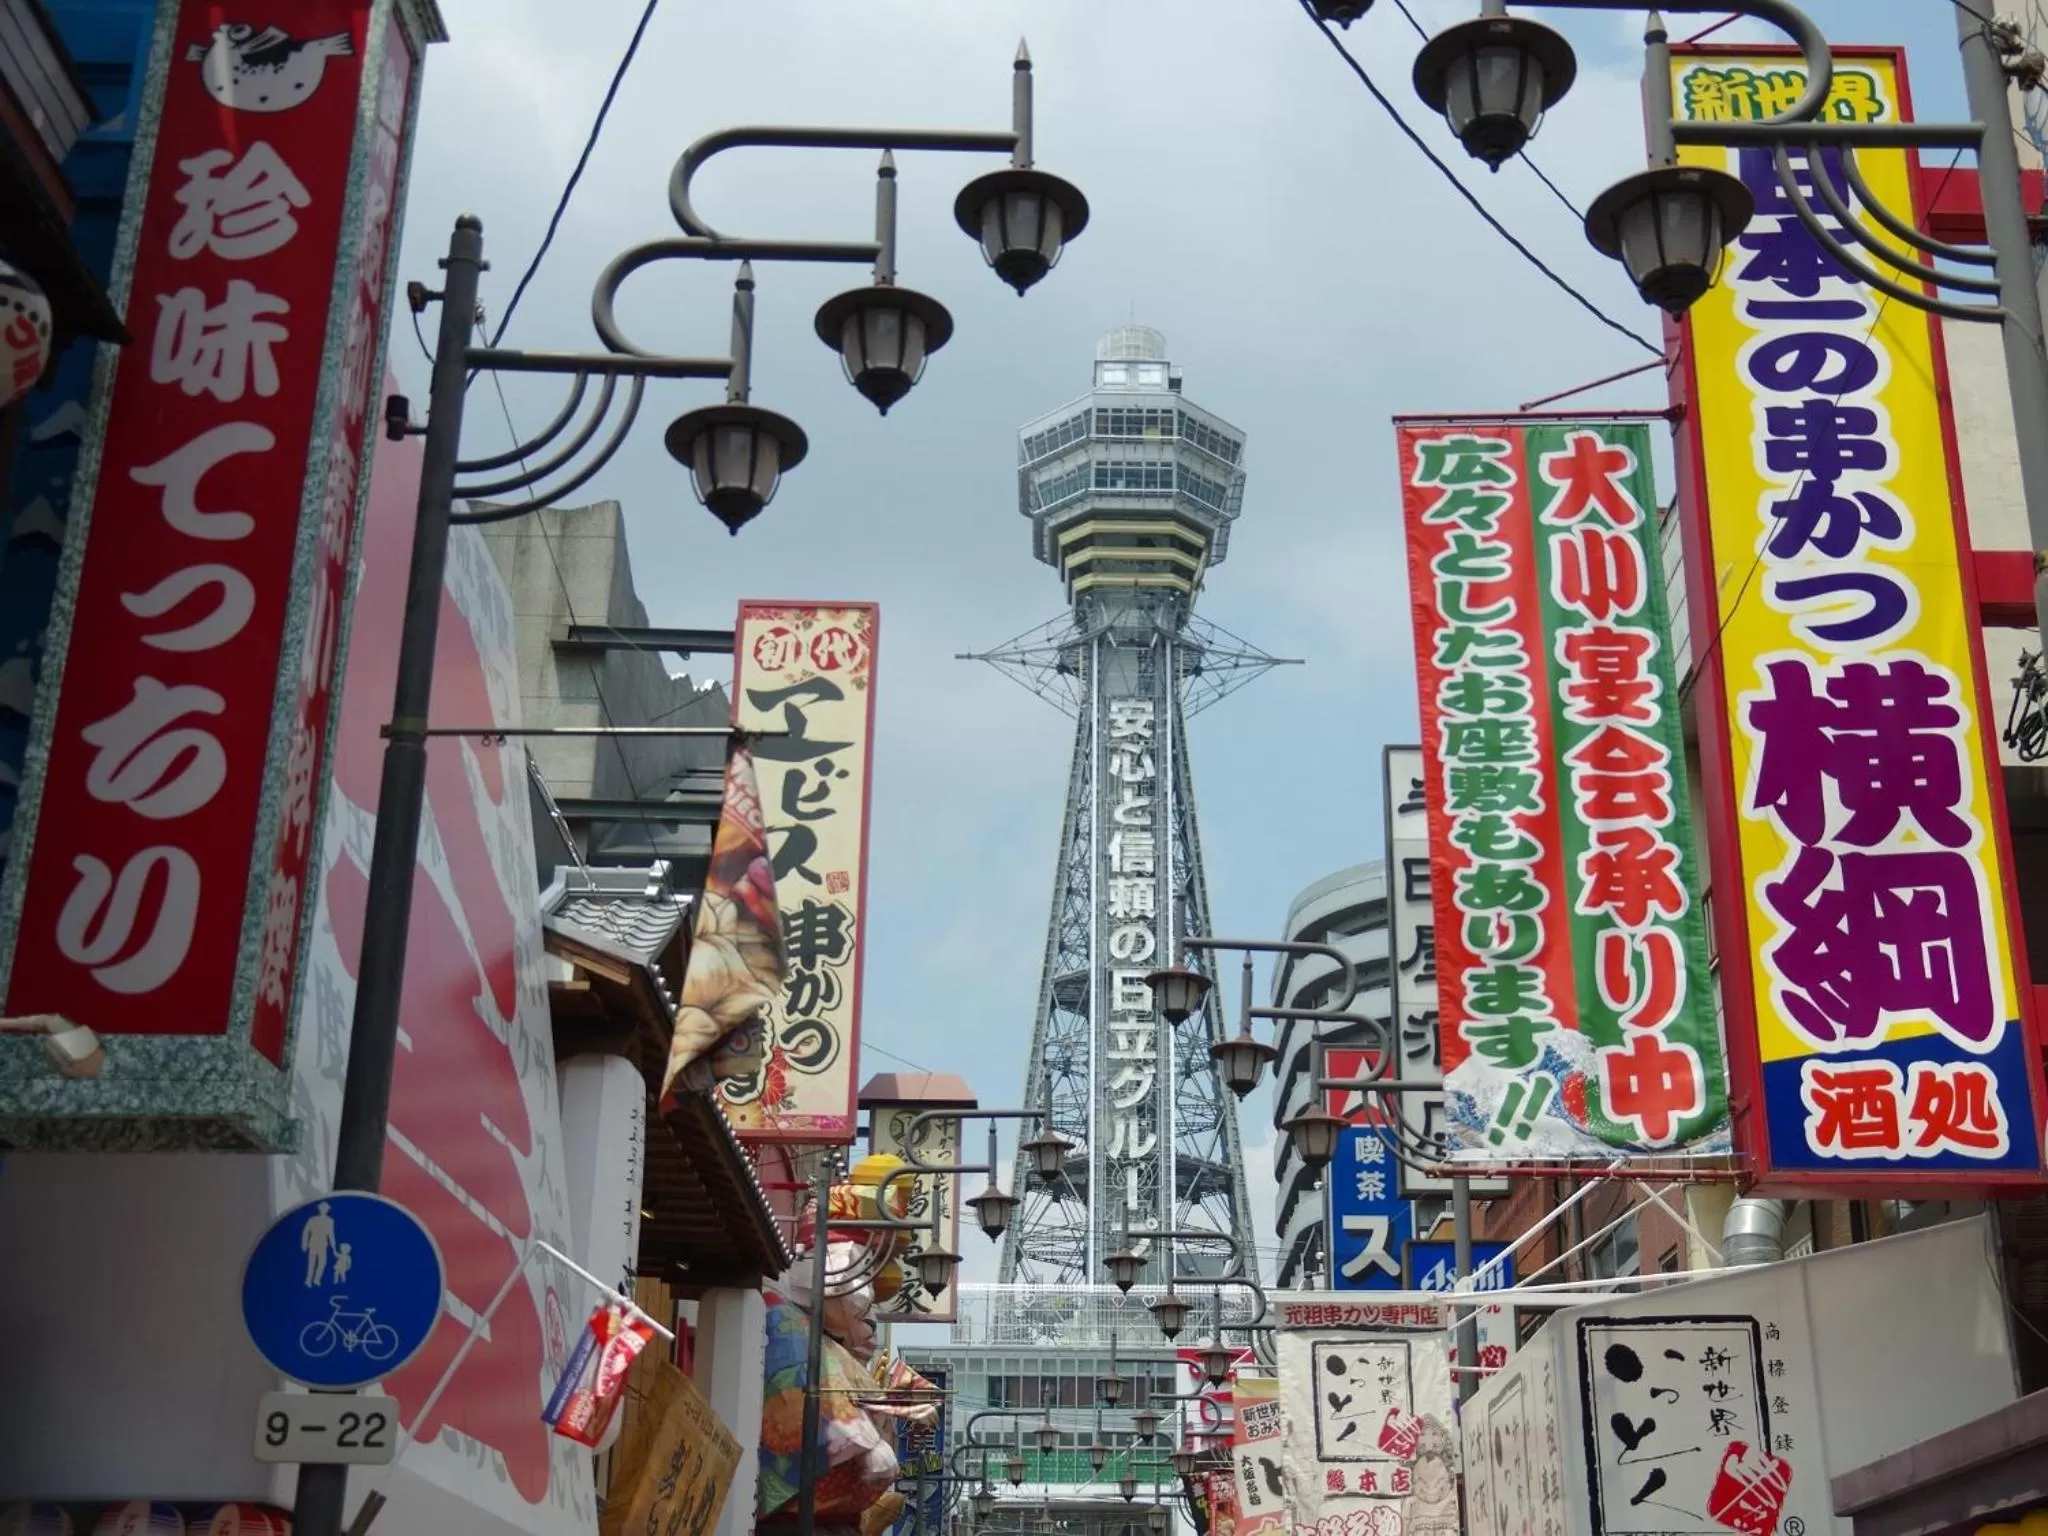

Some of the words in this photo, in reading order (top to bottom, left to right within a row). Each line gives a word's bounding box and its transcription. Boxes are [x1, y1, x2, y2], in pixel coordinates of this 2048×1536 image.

[1684, 67, 1884, 124] 新世界
[1750, 661, 1995, 1042] 横綱
[780, 898, 853, 1071] 串かつ
[1811, 1068, 1999, 1151] 酒処
[1355, 1136, 1386, 1201] 喫茶
[1285, 1304, 1439, 1325] 元祖串カツ専門店
[1421, 1258, 1504, 1290] Ashi
[1700, 1346, 1745, 1437] 新世界
[1765, 1322, 1793, 1451] 商標登録
